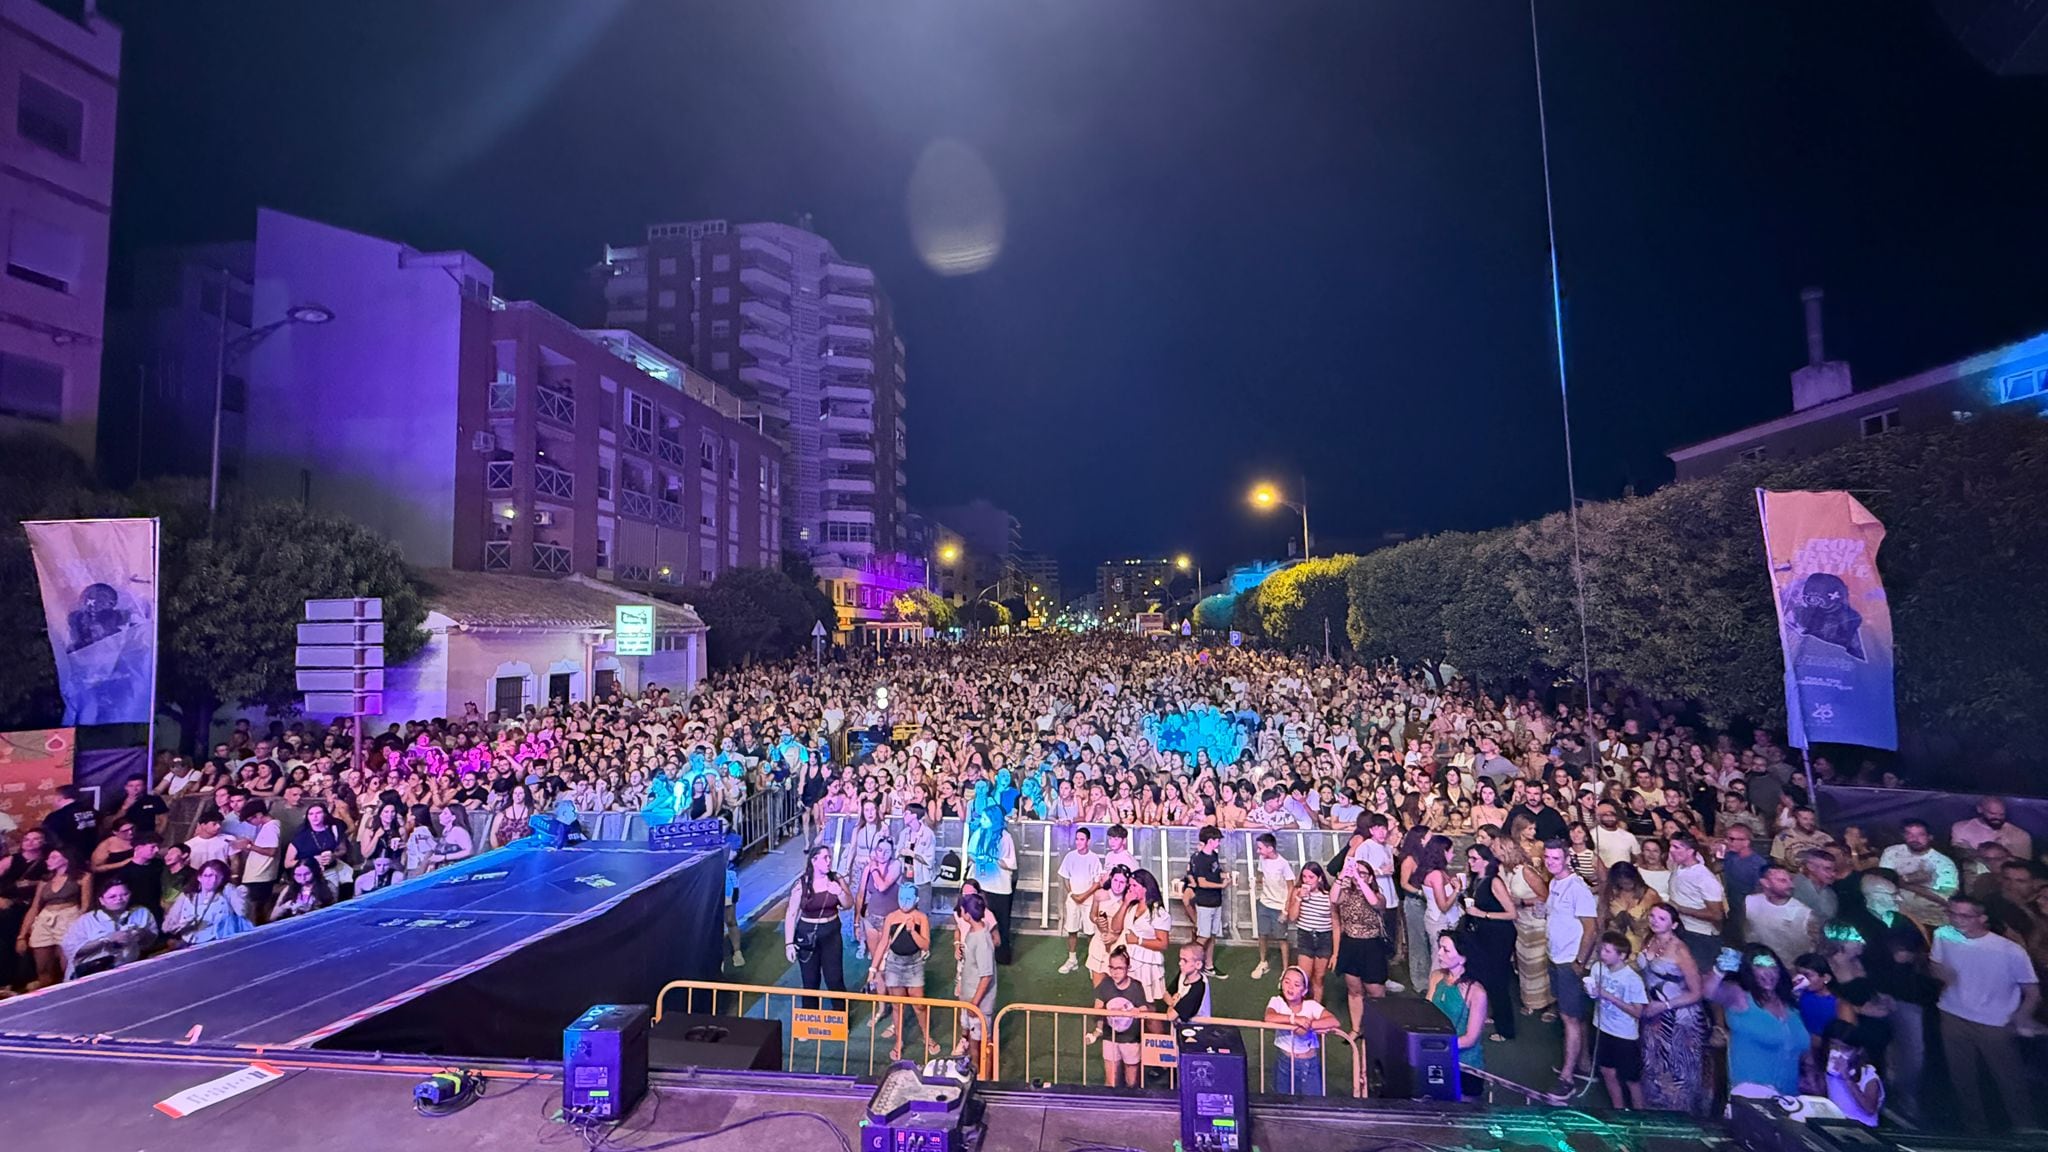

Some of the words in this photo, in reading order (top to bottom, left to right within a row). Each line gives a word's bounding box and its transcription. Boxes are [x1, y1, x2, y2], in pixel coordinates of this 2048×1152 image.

[795, 1013, 821, 1022] POLICIA
[824, 1015, 844, 1024] LOCAL
[1145, 1039, 1174, 1049] POLICIA
